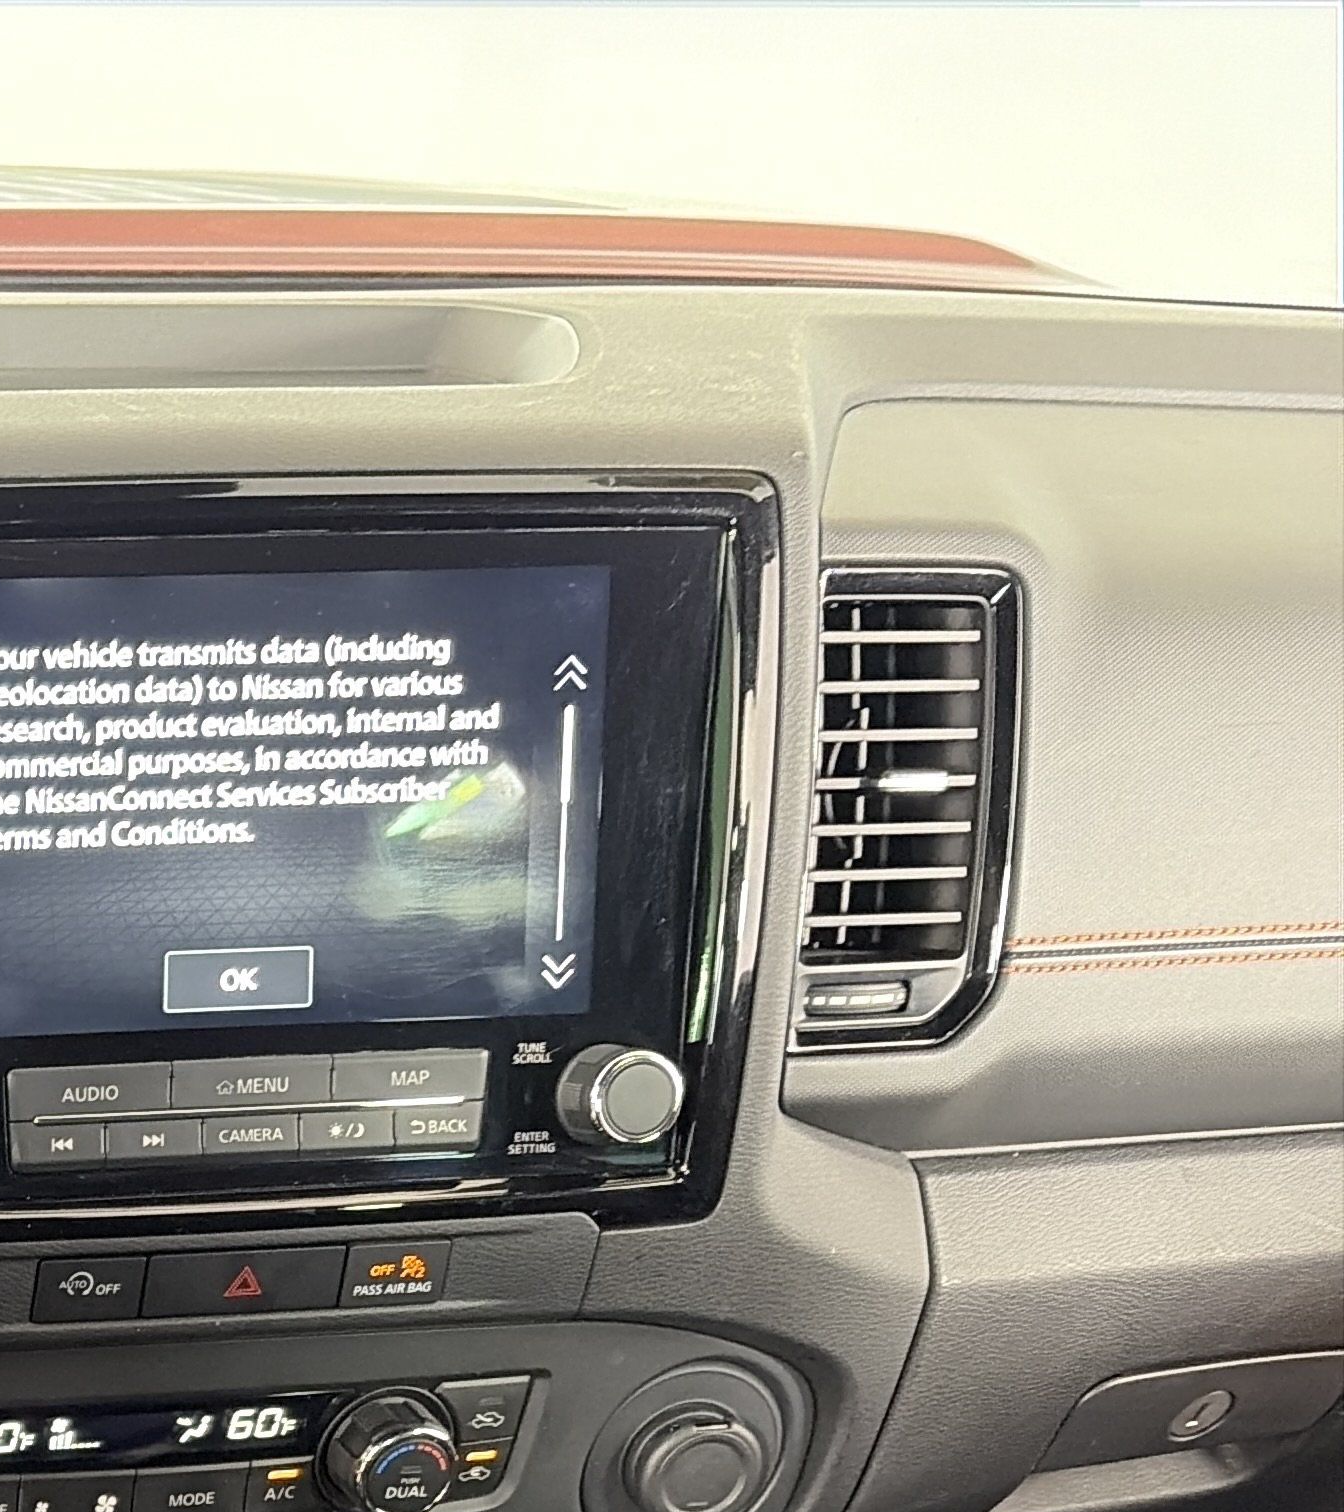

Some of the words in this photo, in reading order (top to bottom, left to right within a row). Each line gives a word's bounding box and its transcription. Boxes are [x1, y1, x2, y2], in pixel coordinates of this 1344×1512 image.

[43, 638, 133, 669] vehicle
[137, 636, 256, 667] transmits
[261, 635, 319, 664] data
[324, 632, 451, 666] (including
[135, 674, 202, 705] data)
[207, 676, 237, 701] to
[242, 673, 323, 700] Nissan
[327, 671, 368, 698] for
[371, 670, 463, 697] various
[95, 711, 198, 746] product
[201, 708, 342, 738] evaluation,
[346, 704, 446, 733] internal
[449, 701, 500, 730] and
[128, 750, 250, 781] purposes,
[254, 745, 280, 771] in
[285, 741, 426, 770] accordance
[429, 738, 489, 766] with
[25, 785, 212, 814] NissanConnect
[217, 781, 316, 809] Services
[319, 775, 451, 806] Subscriber
[56, 819, 107, 849] and
[111, 817, 256, 847] Conditions.
[219, 965, 259, 991] OK
[517, 1041, 547, 1053] TUNE
[511, 1052, 553, 1064] SCROLL
[237, 1077, 290, 1095] MENU
[390, 1070, 431, 1087] MAP
[62, 1085, 119, 1103] AUDIO
[428, 1119, 468, 1135] BACK
[219, 1128, 284, 1143] CAMERA
[514, 1130, 550, 1143] ENTER
[507, 1142, 556, 1155] SETTING
[370, 1264, 395, 1277] OFF
[95, 1283, 121, 1296] OFF
[352, 1283, 384, 1296] PASS
[383, 1282, 406, 1294] AIR
[407, 1280, 432, 1293] BAG
[168, 1491, 216, 1507] MODE
[263, 1485, 296, 1501] A/C
[384, 1485, 429, 1500] DUAL
